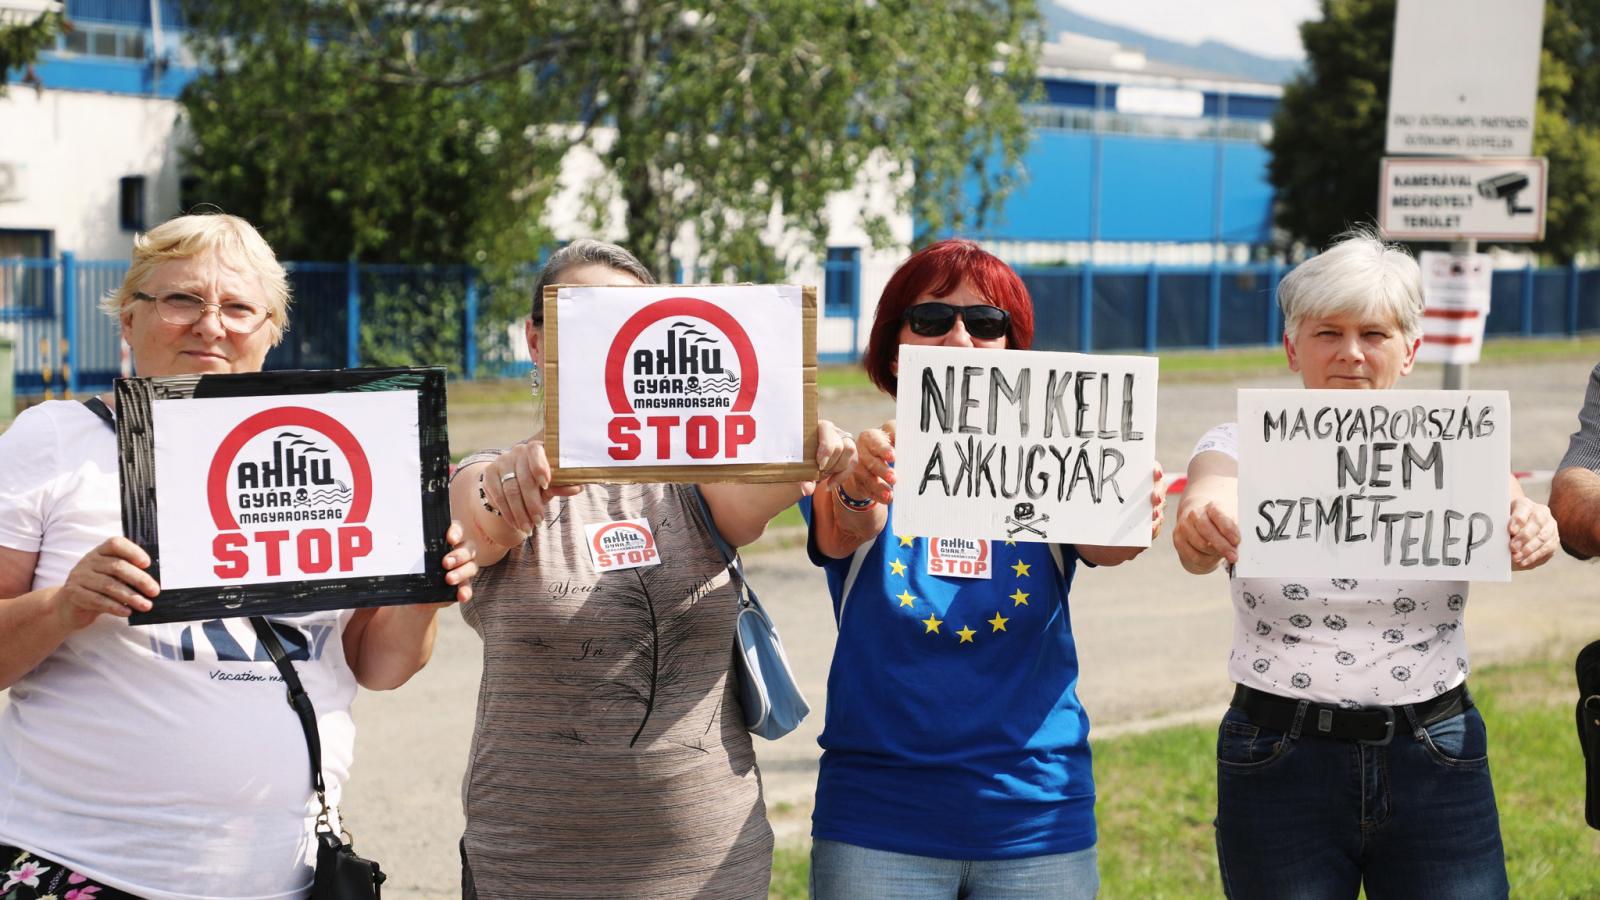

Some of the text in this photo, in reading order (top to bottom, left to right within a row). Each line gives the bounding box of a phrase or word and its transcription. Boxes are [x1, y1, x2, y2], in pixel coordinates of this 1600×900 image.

[1403, 214, 1461, 228] TERÜLET
[633, 329, 724, 375] AKKU
[633, 375, 684, 394] GYÁR
[633, 395, 730, 409] MAGYARORSZÁG
[919, 365, 1144, 442] NEM KELL
[1263, 395, 1496, 442] MAGYARORSZÁG
[607, 414, 756, 461] STOP
[237, 440, 335, 489] AKKU
[918, 435, 1125, 504] AKKUGYÁR
[1337, 441, 1444, 490] NEM
[239, 488, 291, 509] GYÁR
[239, 507, 343, 524] MAGYARORSZÁG
[212, 525, 373, 580] STOP
[597, 549, 656, 567] STOP
[930, 558, 987, 575] STOP
[547, 578, 605, 600] Your
[209, 669, 266, 682] Vacation
